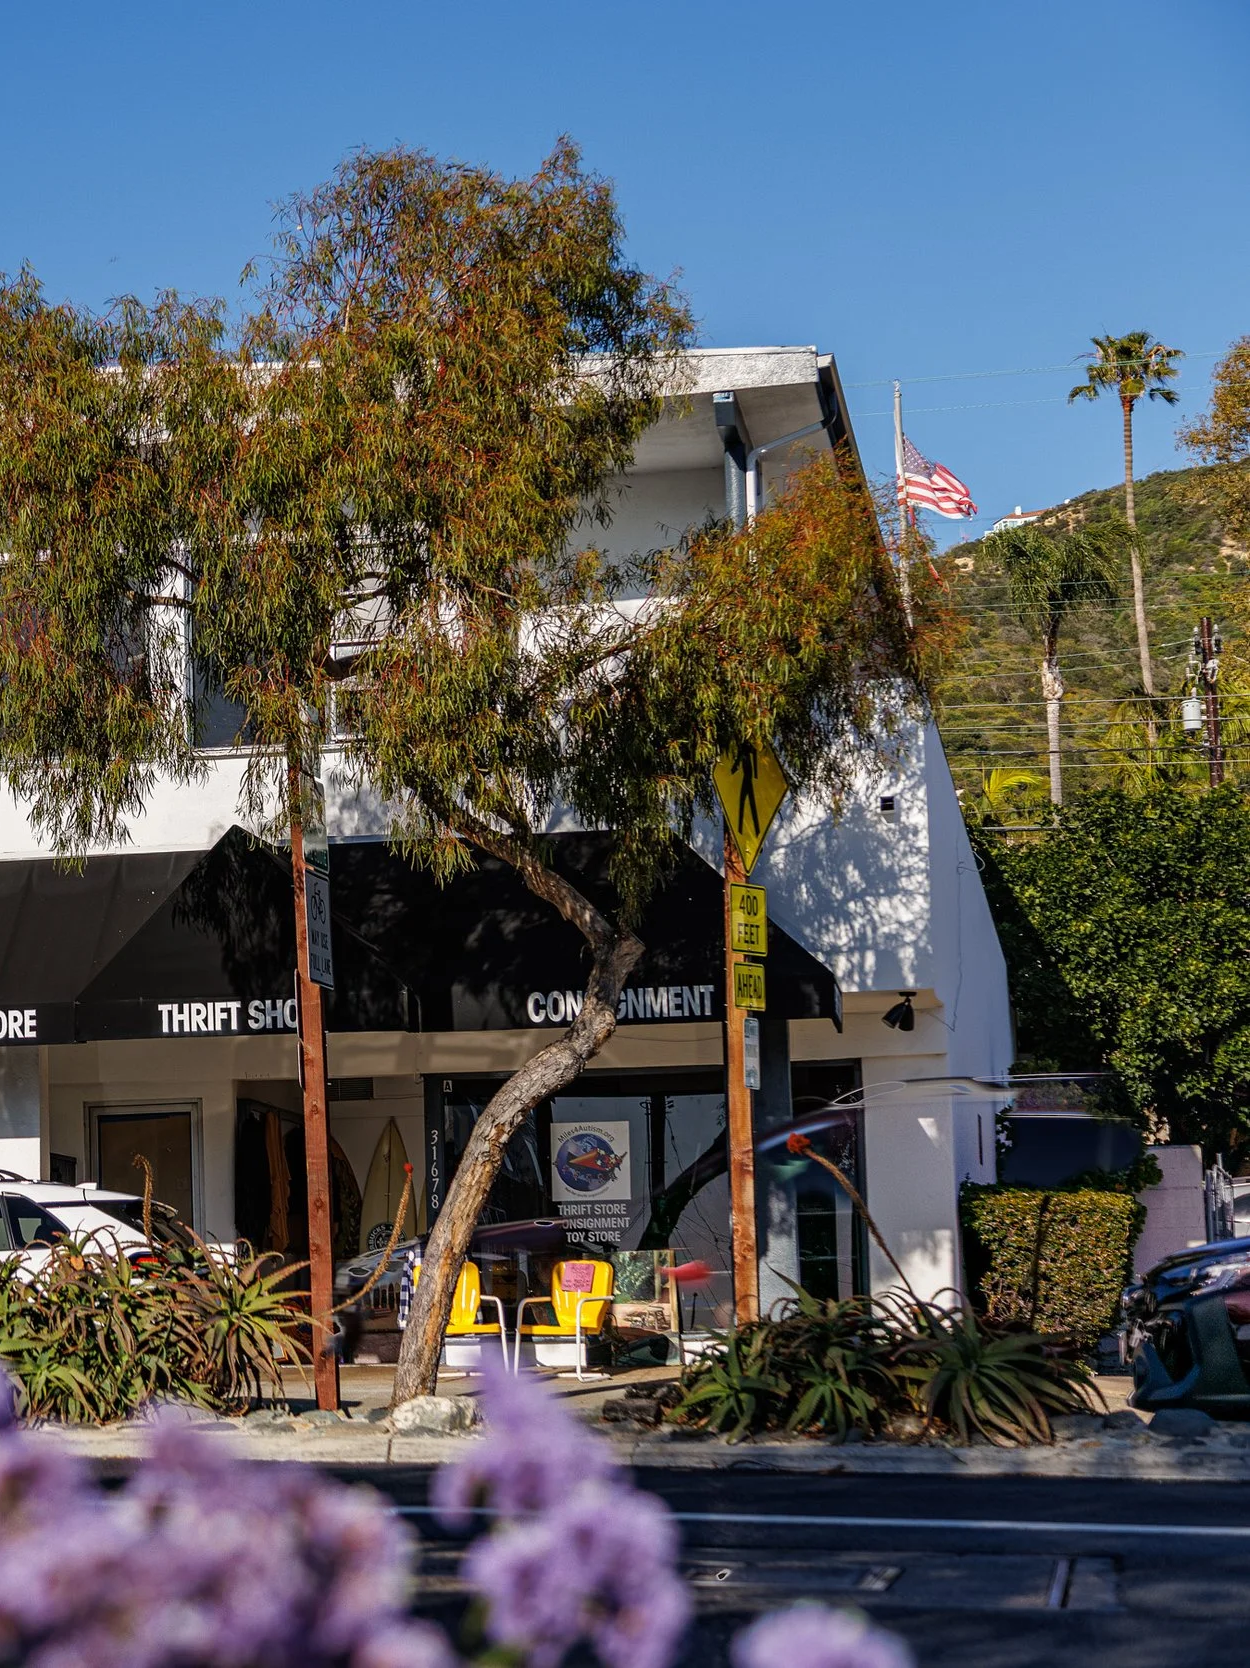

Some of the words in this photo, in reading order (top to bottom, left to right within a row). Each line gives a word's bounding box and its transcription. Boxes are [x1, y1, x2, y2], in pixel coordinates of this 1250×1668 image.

[739, 894, 759, 917] 400
[321, 932, 329, 950] USE
[738, 922, 760, 945] FEET
[310, 951, 321, 973] FULL
[321, 955, 332, 976] LANE
[738, 973, 762, 999] AHEAD
[527, 985, 714, 1023] CONGNMENT
[158, 1001, 241, 1033] THRIFT
[247, 999, 298, 1030] SHO
[444, 1080, 452, 1092] A
[431, 1129, 439, 1209] 31678
[557, 1204, 591, 1216] THRIFT
[594, 1203, 627, 1215] STORE
[562, 1217, 630, 1230] ONSIGNMENT
[566, 1231, 585, 1243] TOY
[588, 1231, 621, 1242] STORE
